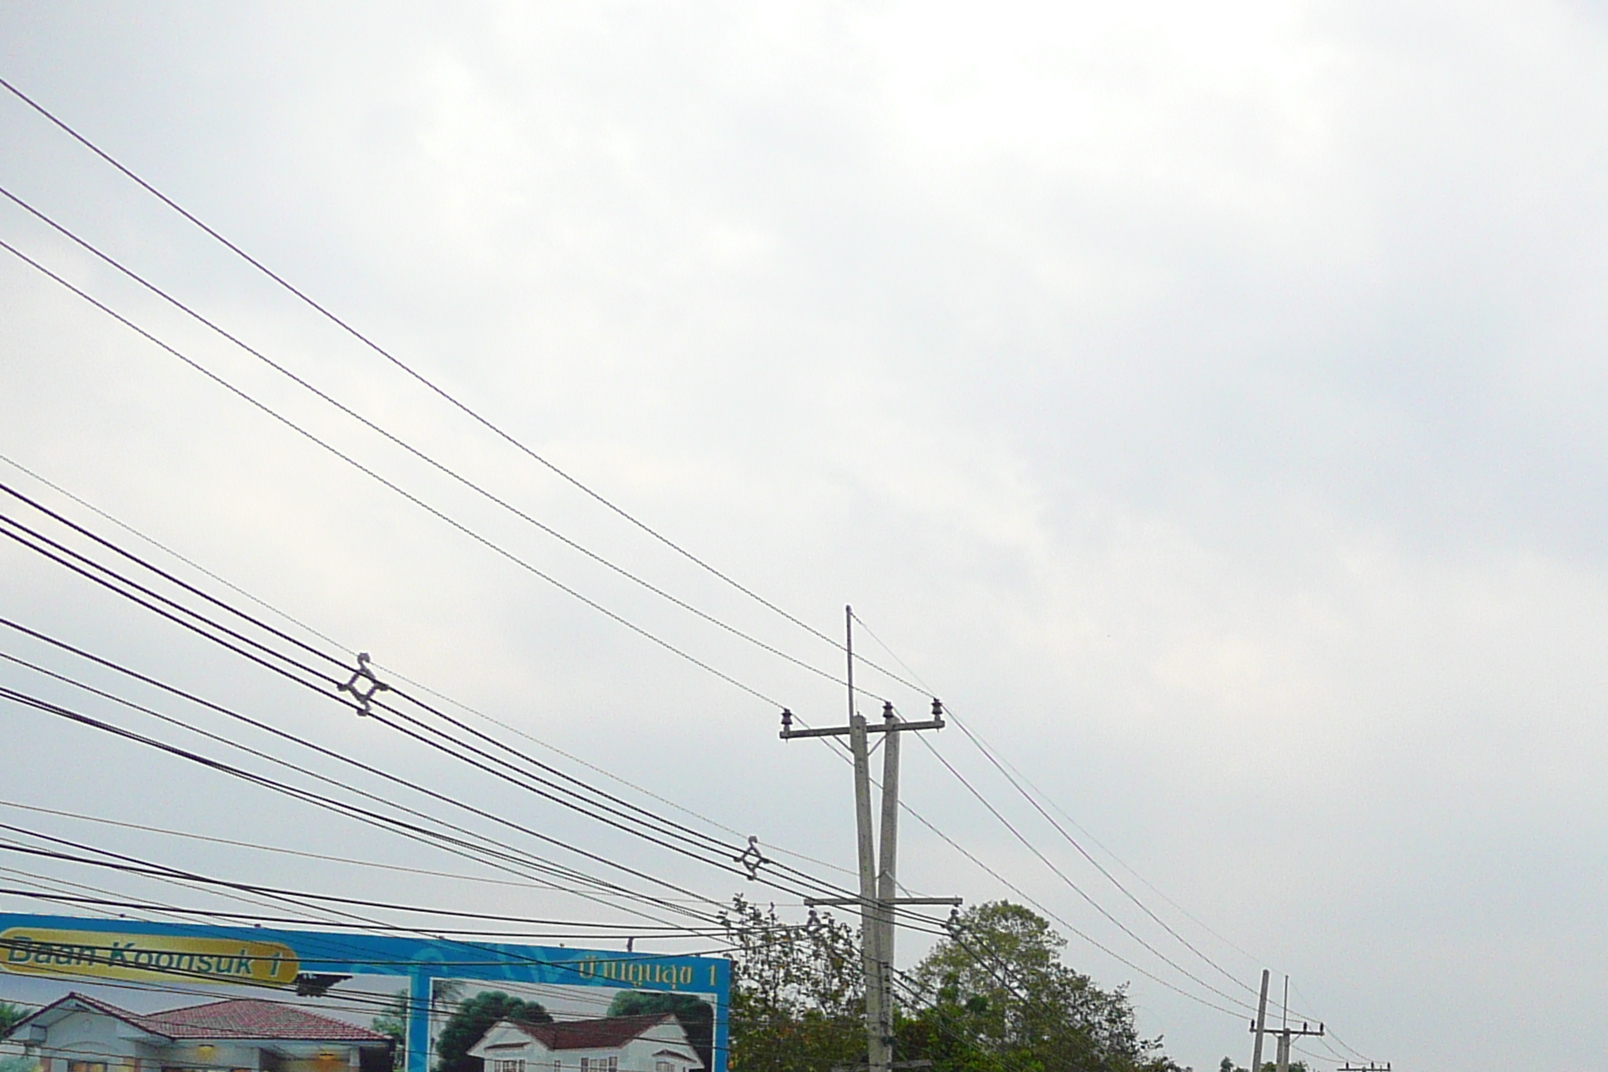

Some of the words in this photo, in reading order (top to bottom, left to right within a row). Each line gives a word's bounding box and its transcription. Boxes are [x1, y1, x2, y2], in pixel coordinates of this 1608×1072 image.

[8, 936, 97, 966] Baan
[108, 942, 254, 977] Koonsuk
[268, 953, 284, 977] 1
[708, 965, 717, 986] 1
